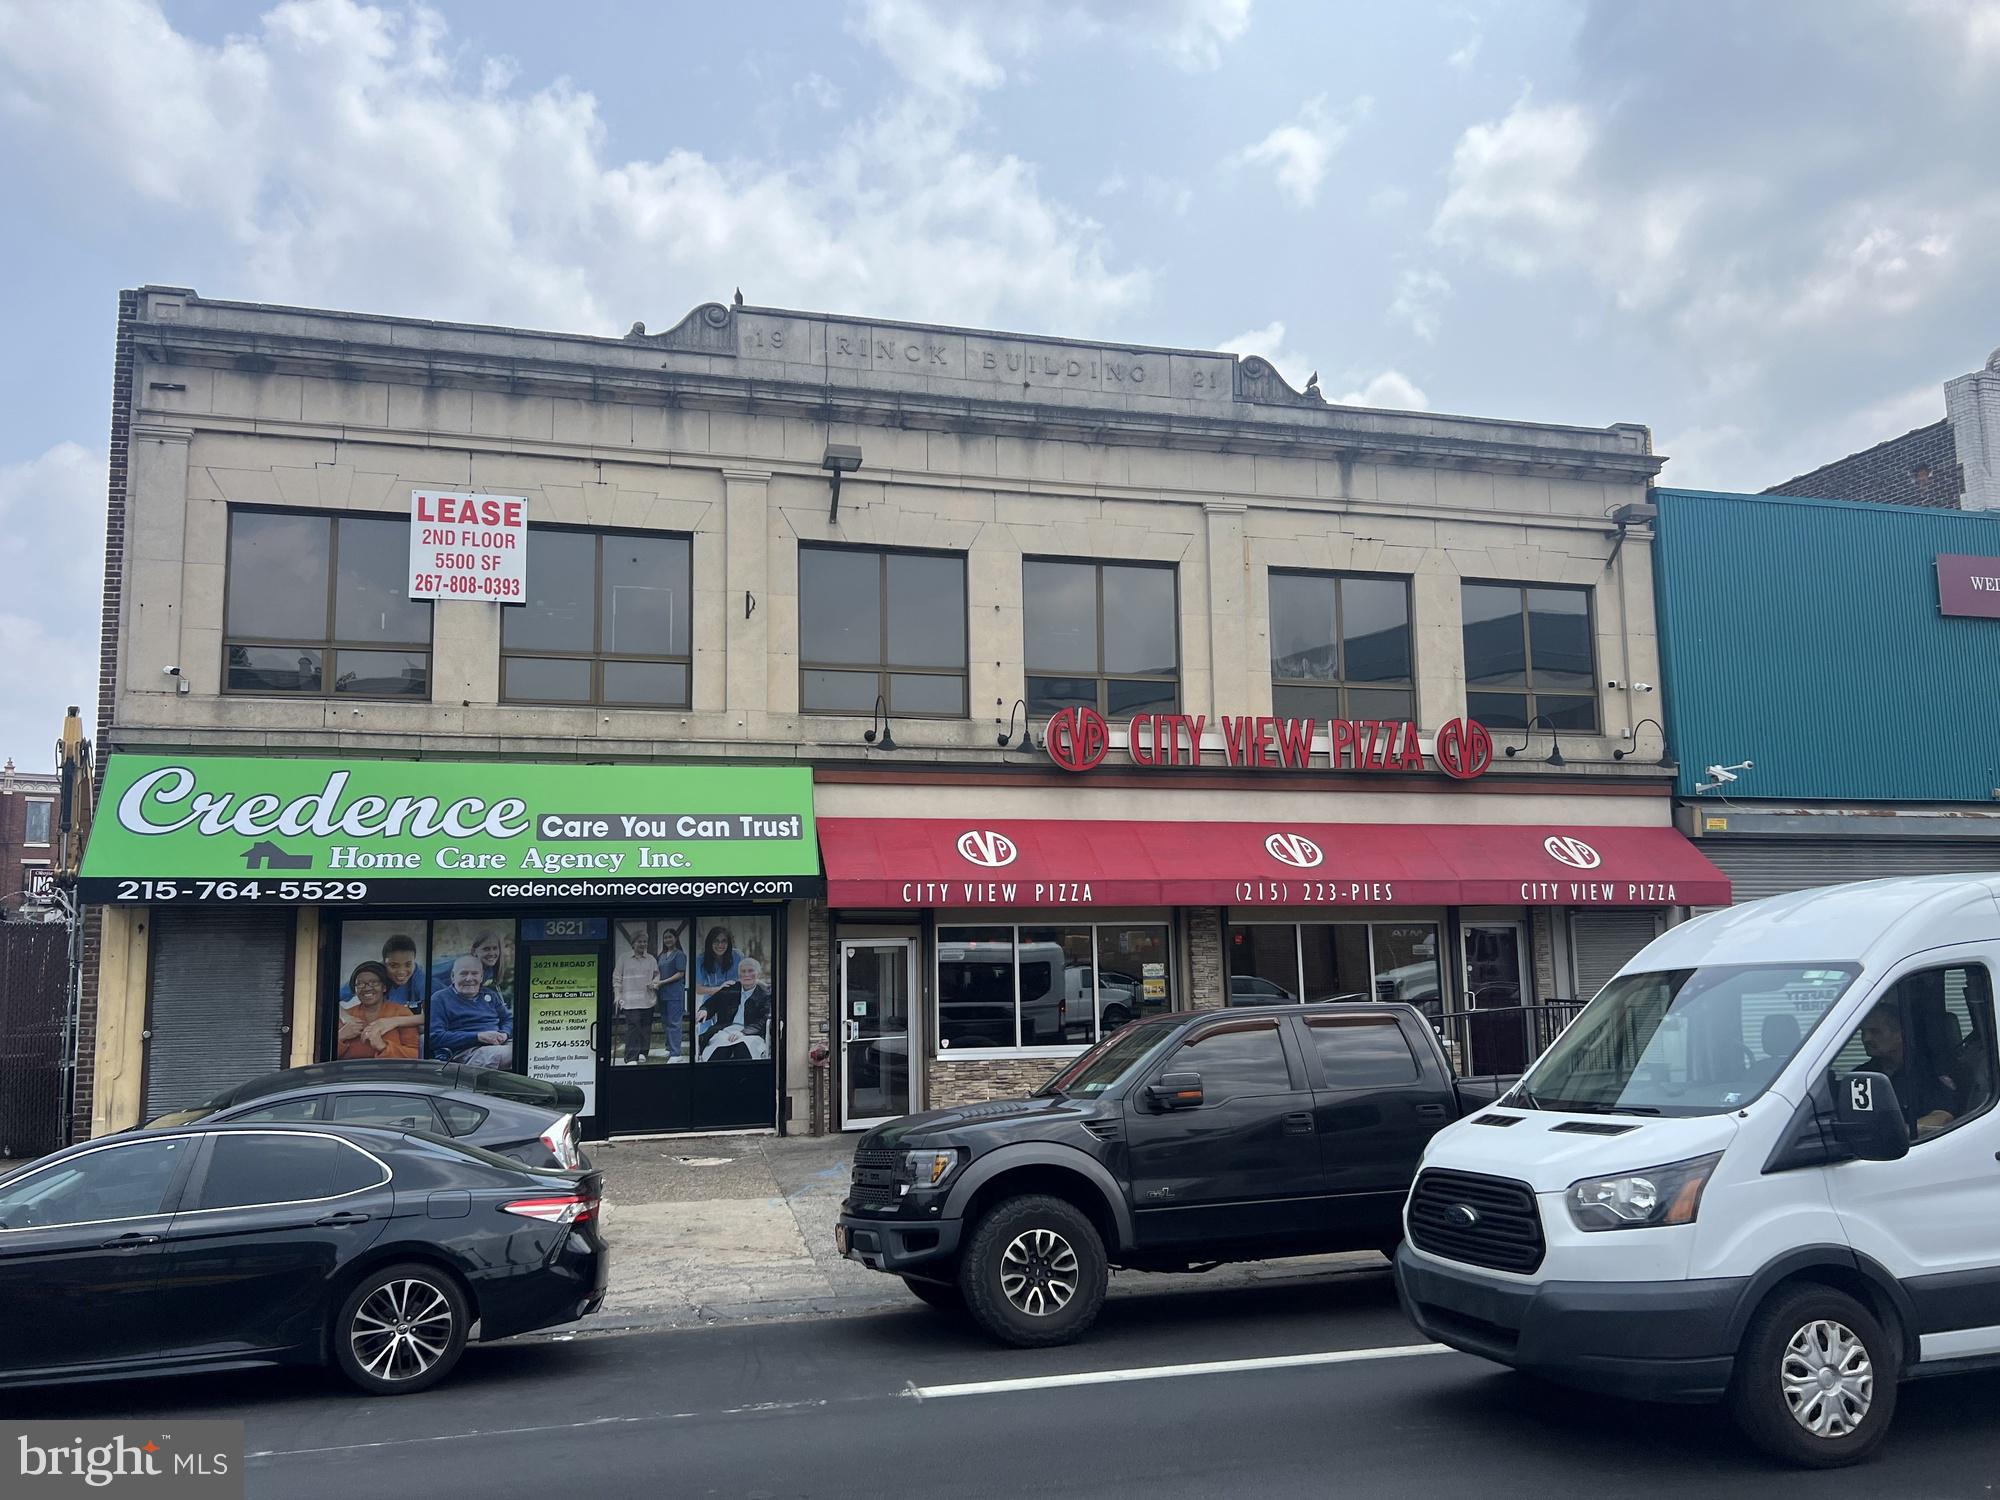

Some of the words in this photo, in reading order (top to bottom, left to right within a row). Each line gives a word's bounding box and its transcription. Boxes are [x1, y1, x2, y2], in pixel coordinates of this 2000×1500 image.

[755, 331, 784, 349] 19
[835, 335, 948, 365] RINCK
[982, 351, 1146, 383] BUILDING
[1193, 371, 1217, 389] 21
[417, 496, 522, 528] LEASE
[422, 528, 456, 546] 2ND
[461, 531, 516, 549] FLOOR
[435, 552, 475, 570] 5500
[481, 554, 502, 571] SF
[415, 573, 520, 596] 267-808-0393
[1129, 714, 1206, 766] CITY
[1221, 715, 1316, 768] VIEW
[1328, 718, 1425, 770] PIZZA
[117, 765, 531, 839] Credence
[541, 815, 609, 838] Care
[620, 815, 666, 838] You
[676, 815, 730, 838] Can
[740, 815, 799, 838] Trust
[328, 846, 421, 869] Home
[435, 846, 507, 869] Care
[520, 847, 625, 873] Agency
[639, 847, 692, 869] Inc.
[116, 880, 367, 900] 215-764-5529
[488, 879, 793, 897] credencehomecareagency.com
[902, 883, 949, 902] CITY
[964, 883, 1017, 902] VIEW
[1036, 883, 1093, 902] PIZZA
[1235, 882, 1289, 902] (215)
[1303, 883, 1393, 901] 223-PIES
[1521, 883, 1558, 900] CITY
[1571, 883, 1614, 901] VIEW
[1629, 884, 1676, 901] PIZZA
[545, 920, 583, 936] 3621
[533, 961, 551, 969] 3621
[560, 960, 586, 968] BROAD
[586, 960, 595, 968] ST
[531, 976, 577, 986] Credence
[535, 1039, 591, 1049] 215-764-5529
[1853, 1078, 1870, 1109] 3
